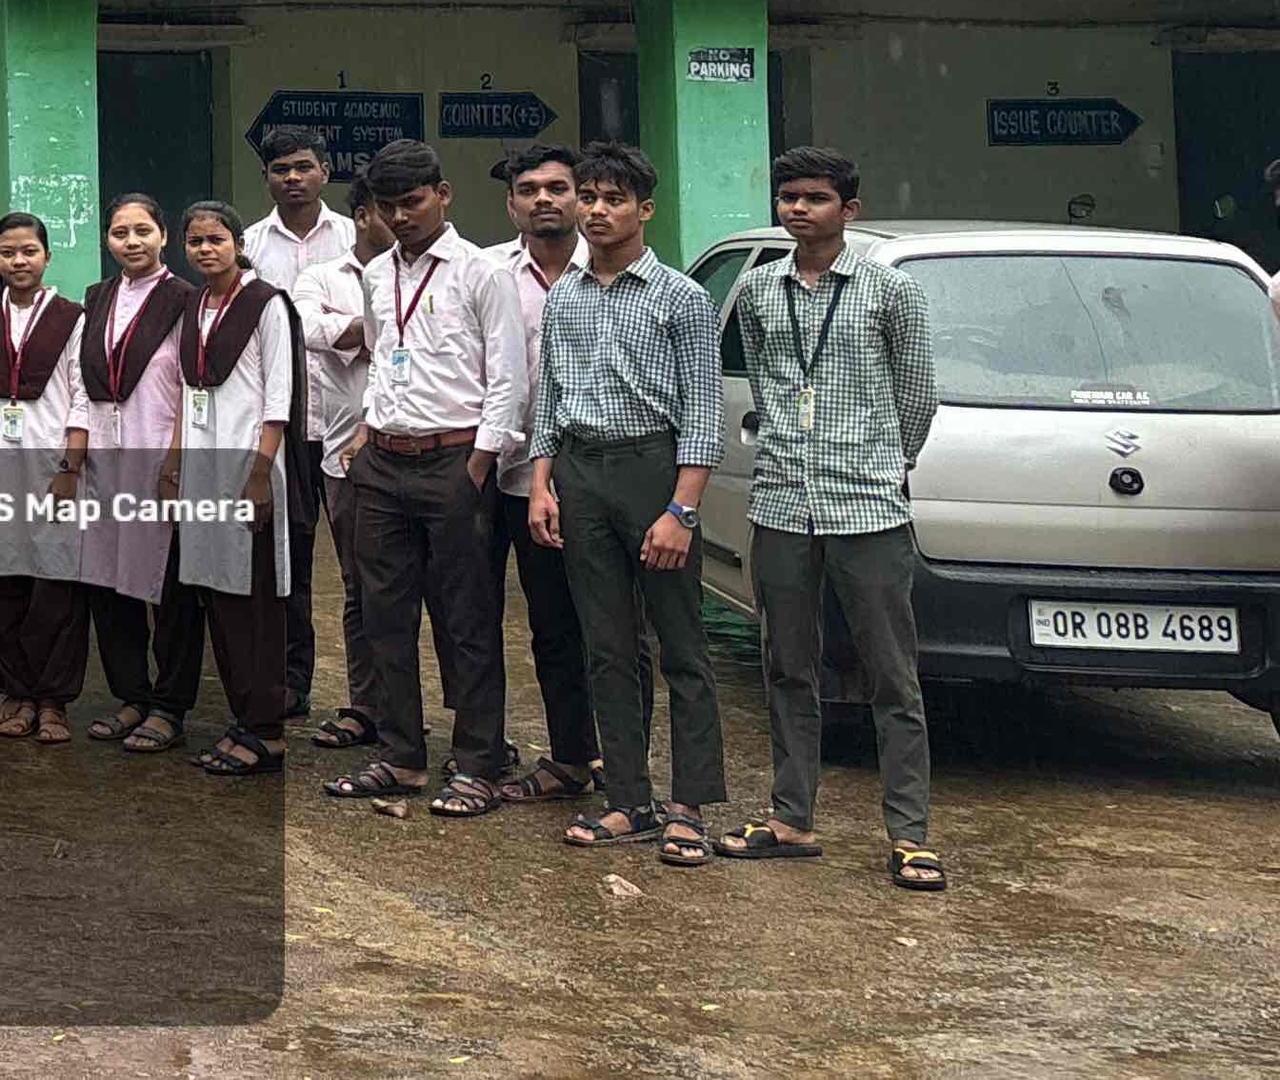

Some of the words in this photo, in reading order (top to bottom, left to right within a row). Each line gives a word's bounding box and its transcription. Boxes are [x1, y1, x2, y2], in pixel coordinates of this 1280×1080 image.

[690, 62, 751, 77] PARKING
[339, 73, 347, 88] 1
[480, 74, 491, 89] 2
[1047, 81, 1060, 95] 3
[282, 101, 337, 117] STUDENT
[344, 102, 400, 118] ACADEMIC
[994, 110, 1040, 134] ISSUE
[1046, 110, 1122, 134] COUNTER
[354, 126, 404, 141] SYSTEM
[1053, 611, 1087, 639] OR
[1097, 612, 1149, 640] 08B
[1162, 613, 1233, 642] 4689
